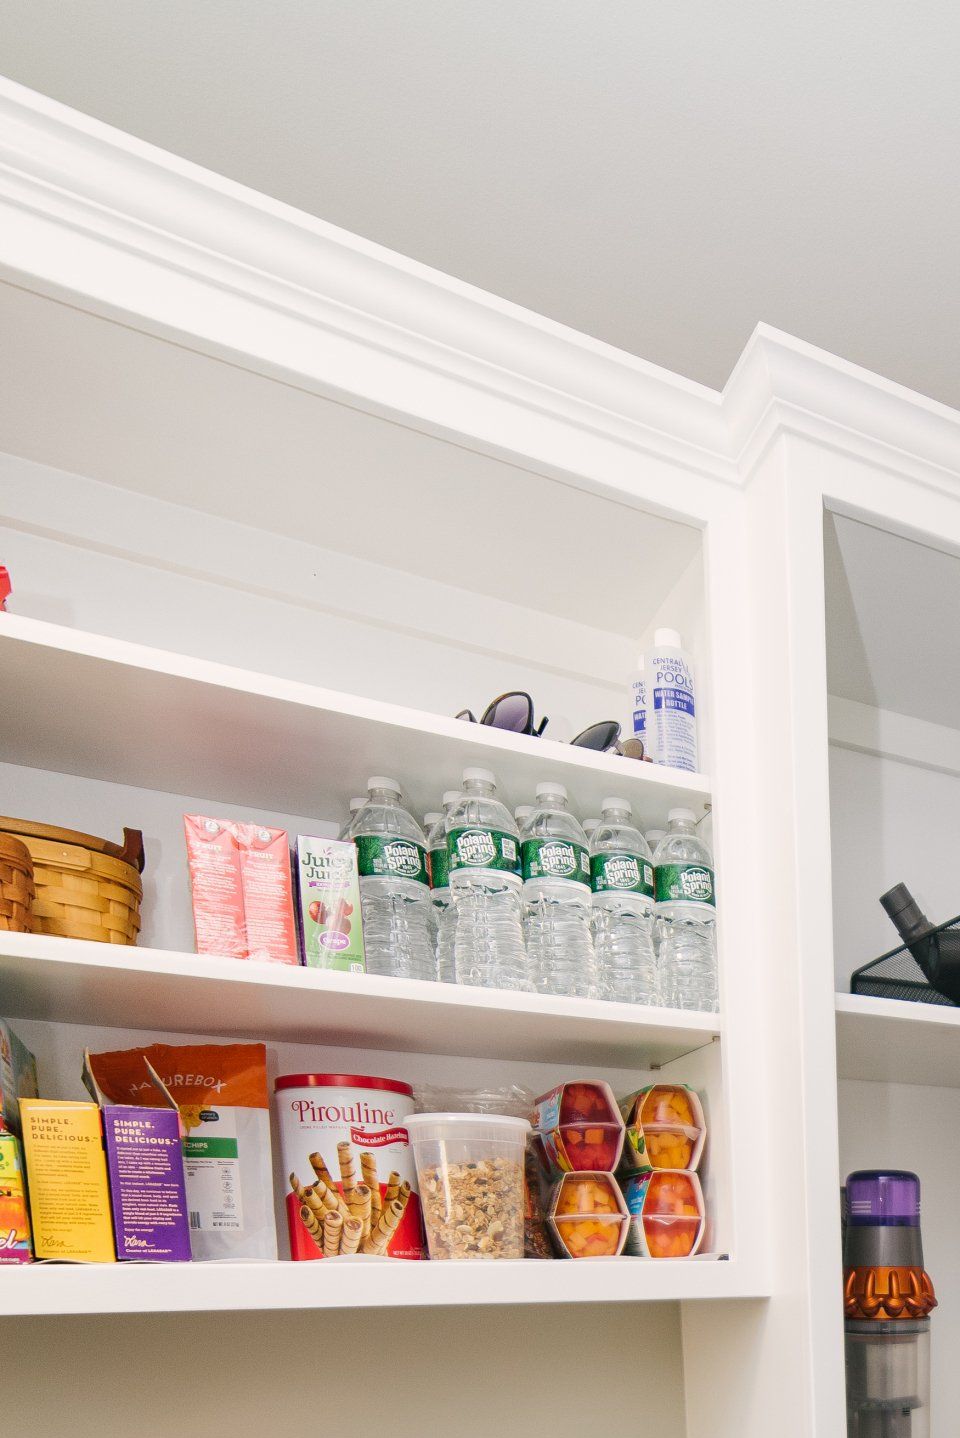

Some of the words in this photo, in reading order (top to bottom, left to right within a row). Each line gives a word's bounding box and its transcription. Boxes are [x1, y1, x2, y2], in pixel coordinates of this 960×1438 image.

[653, 657, 683, 667] CENTRAL
[660, 664, 682, 672] JERSEY
[656, 671, 693, 690] POOLS
[654, 689, 675, 699] WATER
[457, 831, 494, 849] Poland
[384, 844, 419, 858] Poland
[459, 843, 497, 862] Spring
[539, 844, 575, 859] Poland
[388, 856, 421, 871] Spring
[541, 855, 577, 871] Spring
[604, 858, 638, 873] Poland
[606, 869, 641, 885] Spring
[681, 870, 711, 885] Poland
[683, 880, 713, 896] Spring
[128, 1074, 228, 1096] NAUREBOX
[291, 1100, 395, 1126] Pirouline
[30, 1117, 74, 1126] SIMPLE.
[113, 1119, 155, 1129] SIMPLE.
[114, 1127, 145, 1136] PURE.
[353, 1133, 386, 1144] Chocolate
